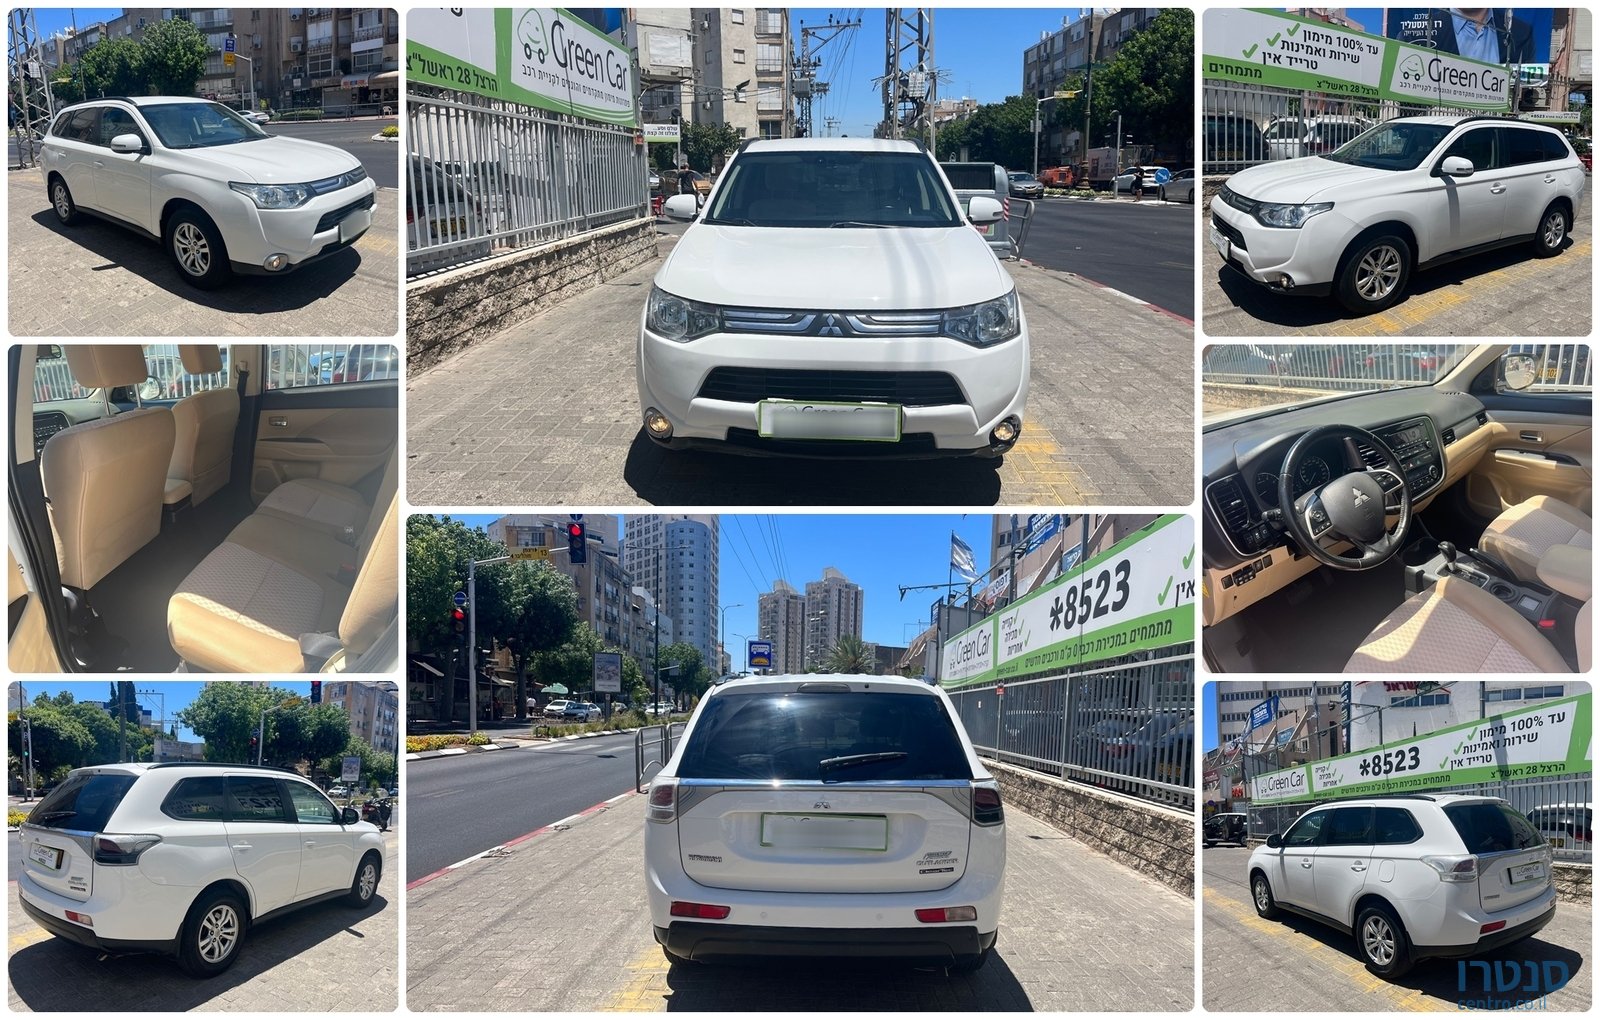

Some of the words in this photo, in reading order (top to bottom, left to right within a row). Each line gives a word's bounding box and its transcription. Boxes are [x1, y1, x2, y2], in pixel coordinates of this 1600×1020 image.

[1400, 20, 1431, 30] ינסטליך
[1303, 29, 1332, 45] מימון
[1336, 36, 1363, 51] 100%
[551, 20, 604, 83] Green
[606, 50, 627, 92] Car
[1281, 39, 1326, 58] ואמינות
[1367, 44, 1379, 55] עד
[1262, 51, 1282, 65] אין
[1286, 55, 1318, 70] טרייד
[1329, 49, 1360, 64] שירות
[456, 66, 471, 85] 28
[522, 64, 537, 78] רכב
[1209, 62, 1262, 78] מתמחים
[1428, 58, 1477, 89] Green
[1481, 70, 1504, 93] Car
[473, 70, 498, 92] הרצל
[538, 69, 560, 87] לקניית
[1317, 79, 1348, 92] ראשל"צ
[1350, 84, 1360, 93] 28
[1362, 86, 1379, 96] הרצל
[1413, 84, 1432, 92] לקניית
[1130, 619, 1172, 643] מתמחים
[956, 638, 976, 664] Green
[977, 629, 991, 656] Car
[1096, 634, 1126, 651] במכירת
[1511, 716, 1543, 732] 100%
[1548, 711, 1566, 724] עד
[1480, 724, 1506, 741] מימון
[1503, 732, 1538, 747] שירות
[1463, 739, 1500, 754] ואמינות
[1450, 758, 1464, 770] אין
[1466, 754, 1492, 766] טרייד
[1540, 762, 1566, 773] הרצל
[1491, 768, 1523, 779] ראשל"צ
[1526, 765, 1538, 774] 28
[1268, 776, 1289, 791] Green
[1291, 772, 1304, 787] Car
[1400, 778, 1420, 788] במכירת
[1423, 774, 1451, 785] מתמחים
